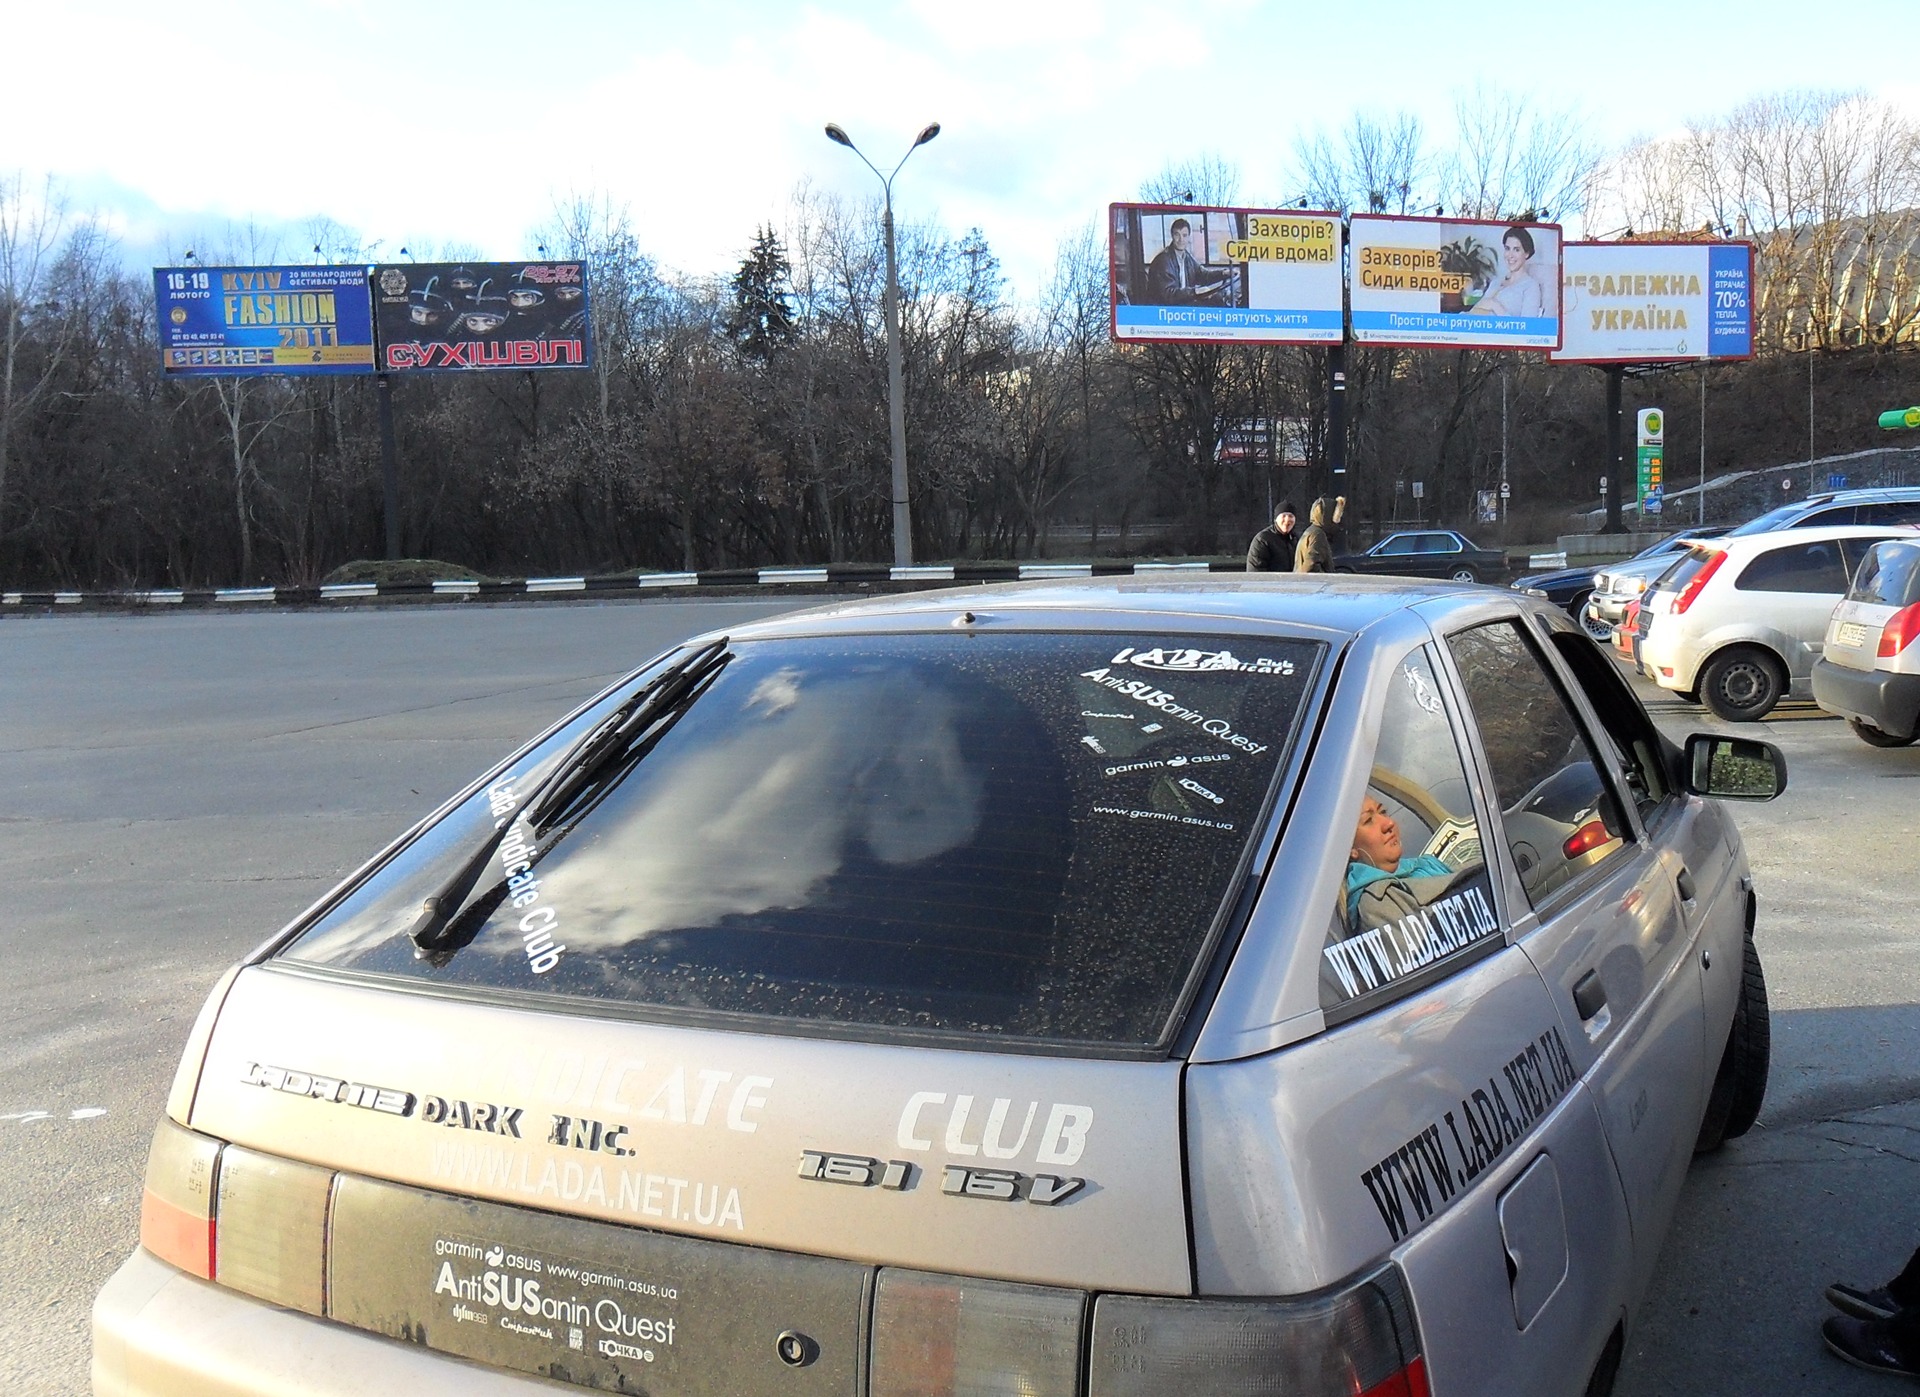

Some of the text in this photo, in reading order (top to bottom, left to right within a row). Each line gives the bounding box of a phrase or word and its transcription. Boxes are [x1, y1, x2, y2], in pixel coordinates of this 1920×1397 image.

[1250, 219, 1333, 240] Захворів?
[1226, 241, 1334, 263] Сиди вдома!
[1362, 248, 1443, 271] Захворів?
[167, 272, 210, 290] 16-19
[222, 272, 282, 291] KYIV
[289, 269, 363, 279] 20 МІЖНАРОДНИЙ
[289, 278, 364, 286] ФЕСТИВАЛЬ МОДИ
[1362, 270, 1466, 292] Сиди вдома!
[1715, 269, 1744, 278] УКРАЇНА
[1715, 281, 1746, 289] ВТРАЧАЄ
[224, 293, 336, 326] FASHION
[1715, 291, 1746, 308] 70%
[1158, 308, 1308, 328] Прості речі рятують життя
[1389, 314, 1526, 333] Прості речі рятують життя
[1591, 304, 1688, 331] УКРАЇНА
[1715, 311, 1738, 319] ТЕПЛА
[278, 327, 338, 349] 2011
[387, 340, 583, 368] СУХІШВІЛІ
[1256, 657, 1294, 669] Club
[1080, 667, 1270, 756] AntiSUSanin Quest
[1105, 753, 1231, 776] garmin asus
[1093, 805, 1234, 831] www.garmin.asus.ua
[488, 775, 522, 818] Lada
[518, 906, 567, 975] Club
[1323, 886, 1498, 999] WWW.LADA.NET.UA
[240, 1061, 346, 1103] LADA
[422, 1095, 637, 1158] DARK INC.
[898, 1090, 1095, 1167] CLUB
[1360, 1025, 1577, 1245] WWW.LADA.NET.UA
[430, 1140, 745, 1231] WWW.LADA.NET.UA
[435, 1239, 678, 1301] garmin asus www.garmin.asus.ua
[434, 1261, 676, 1345] AntiSUSanin Quest
[599, 1339, 643, 1360] ТОЧКА
